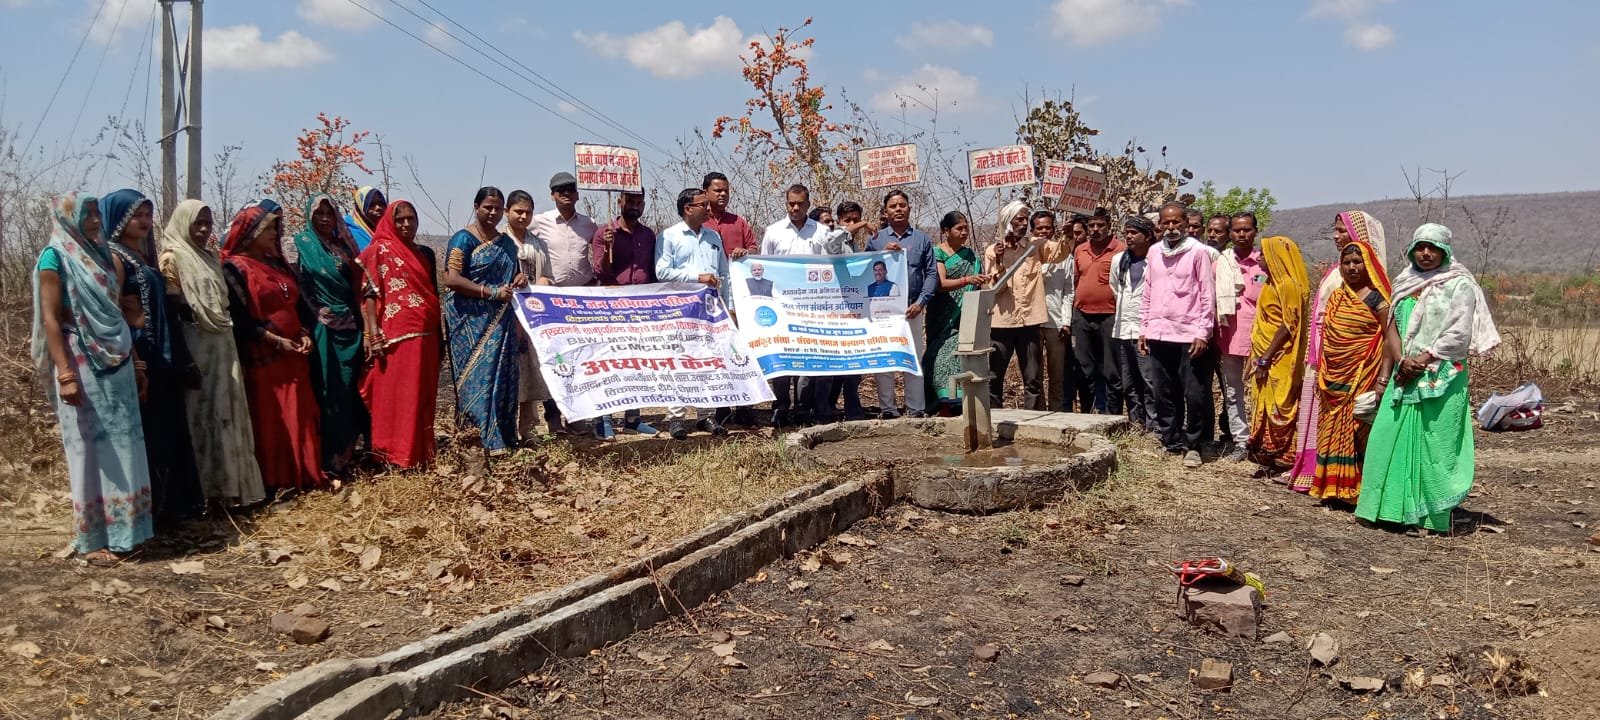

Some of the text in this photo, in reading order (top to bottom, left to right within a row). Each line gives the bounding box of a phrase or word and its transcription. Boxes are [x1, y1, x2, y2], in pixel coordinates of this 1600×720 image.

[577, 151, 593, 165] पानी
[975, 147, 1026, 170] जल है तो कल है
[972, 165, 1032, 188] जल बचाना सरल है
[1048, 165, 1060, 178] जल
[550, 297, 584, 309] म.प्र.
[584, 300, 609, 310] जन
[609, 298, 661, 309] अभियान
[781, 300, 864, 312] जल गंगा संवर्धन अभियान
[540, 324, 580, 339] मुख्यमंत्री
[567, 337, 597, 345] BSW
[607, 336, 638, 344] MSW
[748, 337, 772, 349] नवांकुर
[773, 334, 790, 344] संस्था
[819, 338, 838, 347] समाज
[610, 344, 685, 353] (CMCLDP)
[581, 354, 727, 376] अध्ययन केन्द्र
[594, 396, 638, 410] आपका
[641, 394, 676, 404] हार्दिक
